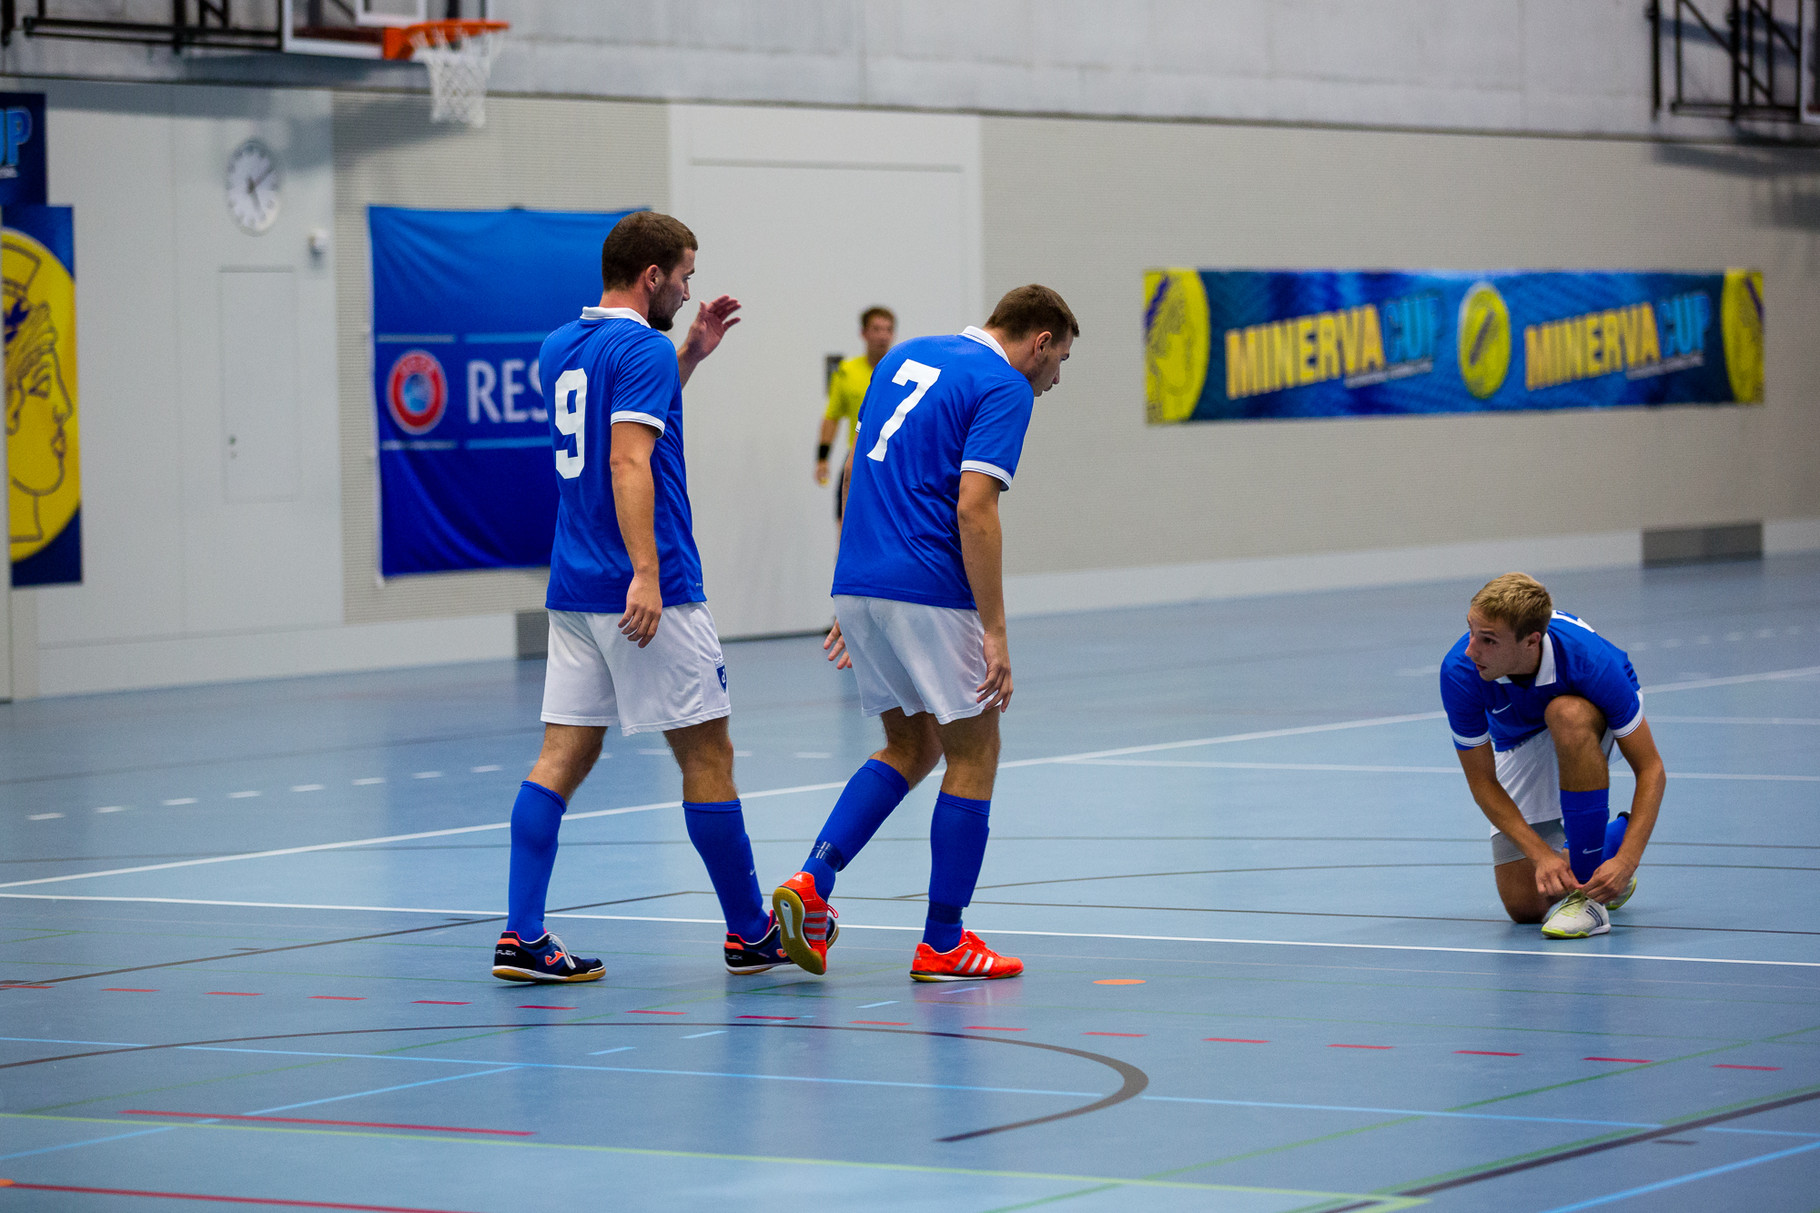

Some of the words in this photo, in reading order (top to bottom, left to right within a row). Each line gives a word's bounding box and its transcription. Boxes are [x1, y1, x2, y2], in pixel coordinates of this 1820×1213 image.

[1225, 303, 1386, 399] MINERVA
[1384, 290, 1442, 363] CUP
[1525, 302, 1661, 391] MINERVA
[1658, 291, 1711, 358] CUP
[555, 368, 588, 479] 9
[866, 358, 941, 462] 7
